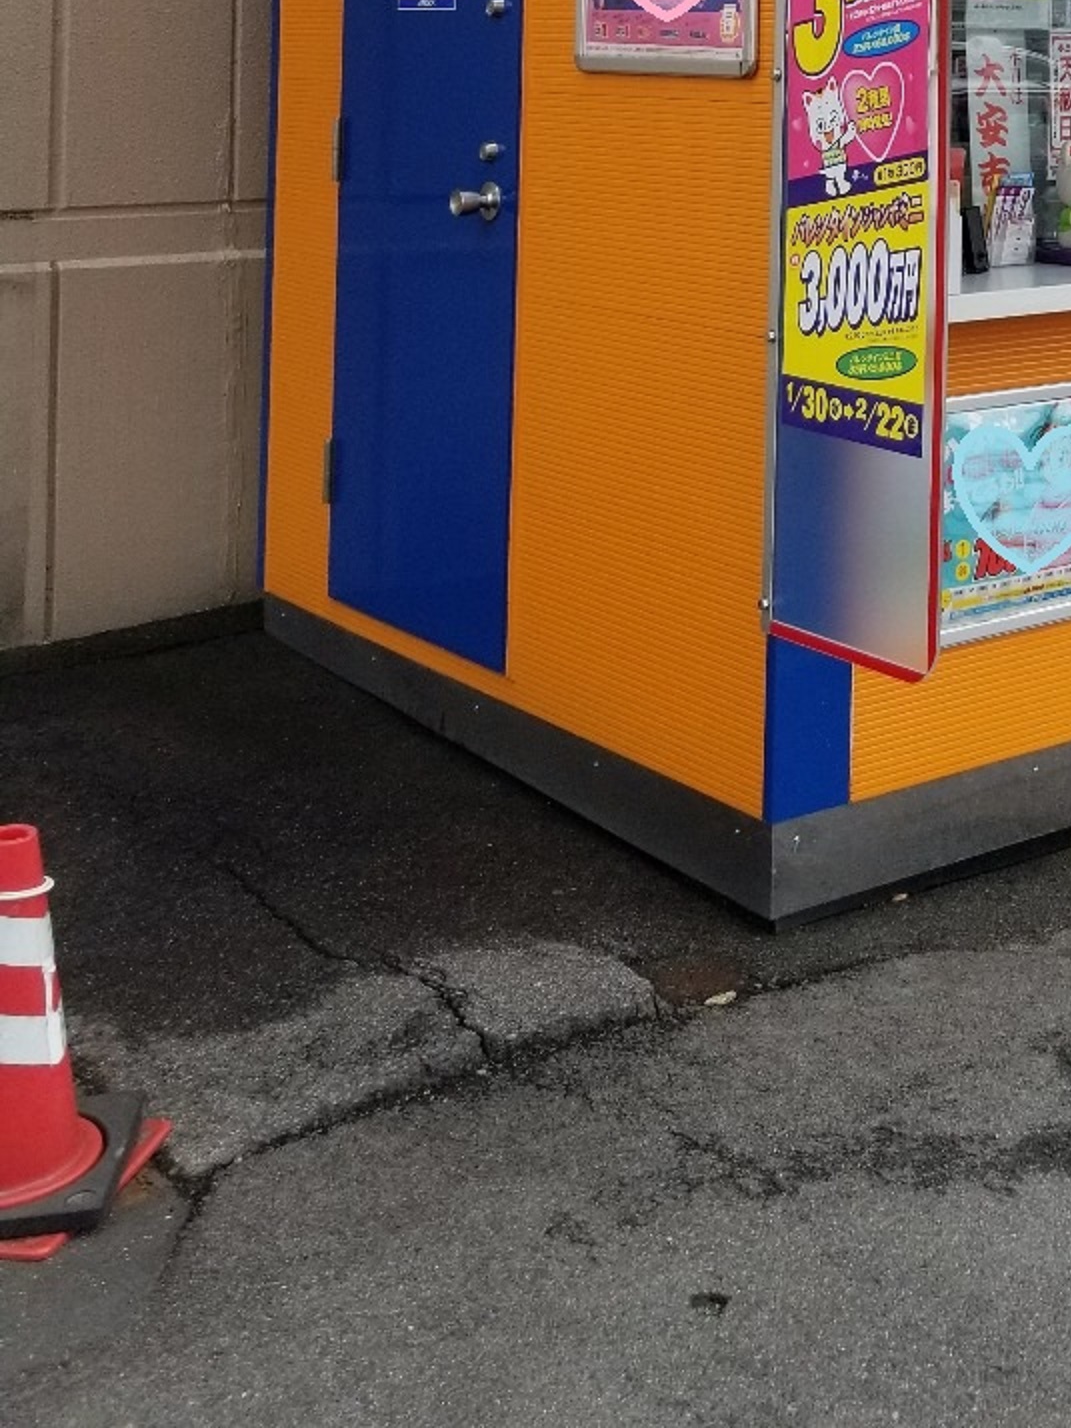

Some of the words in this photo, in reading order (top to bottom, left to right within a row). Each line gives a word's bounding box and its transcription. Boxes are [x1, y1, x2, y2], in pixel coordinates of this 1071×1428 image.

[743, 3, 845, 65] 宝くじ発売中
[973, 53, 1011, 213] 大安吉
[798, 238, 922, 337] 3,000万円
